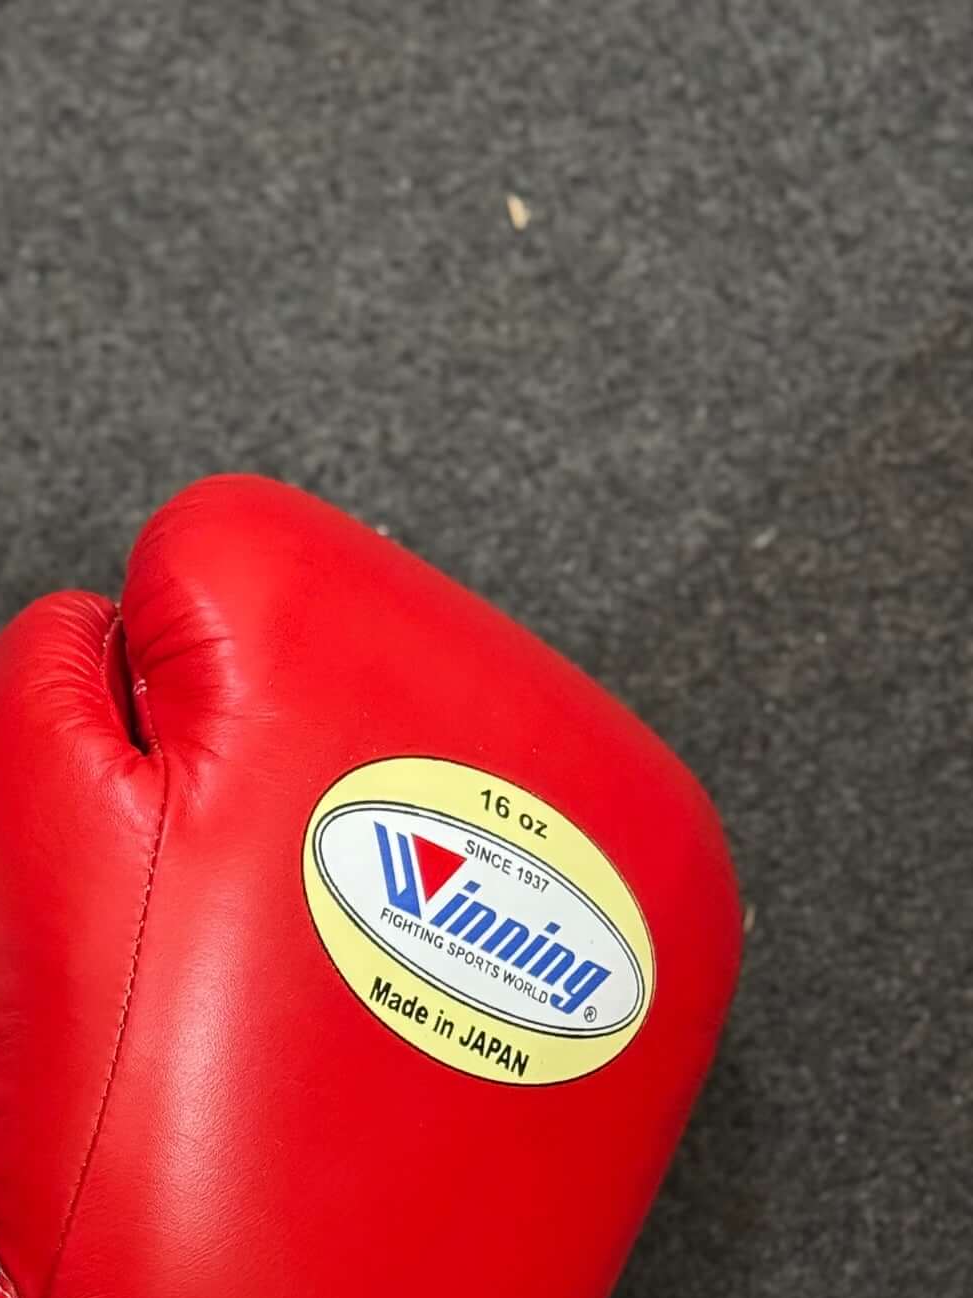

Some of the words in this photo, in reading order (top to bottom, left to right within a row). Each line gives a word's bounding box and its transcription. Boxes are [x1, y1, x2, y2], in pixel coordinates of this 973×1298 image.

[480, 789, 510, 819] 16
[519, 813, 548, 839] oz
[464, 839, 511, 875] SINCE
[517, 866, 550, 893] 1937
[373, 821, 612, 1015] Winning
[380, 907, 443, 949] FIGHTING
[447, 942, 499, 978] SPORTS
[503, 971, 548, 1005] WORLD
[369, 976, 429, 1025] Made
[435, 1010, 454, 1038] in
[459, 1026, 530, 1077] JAPAN
